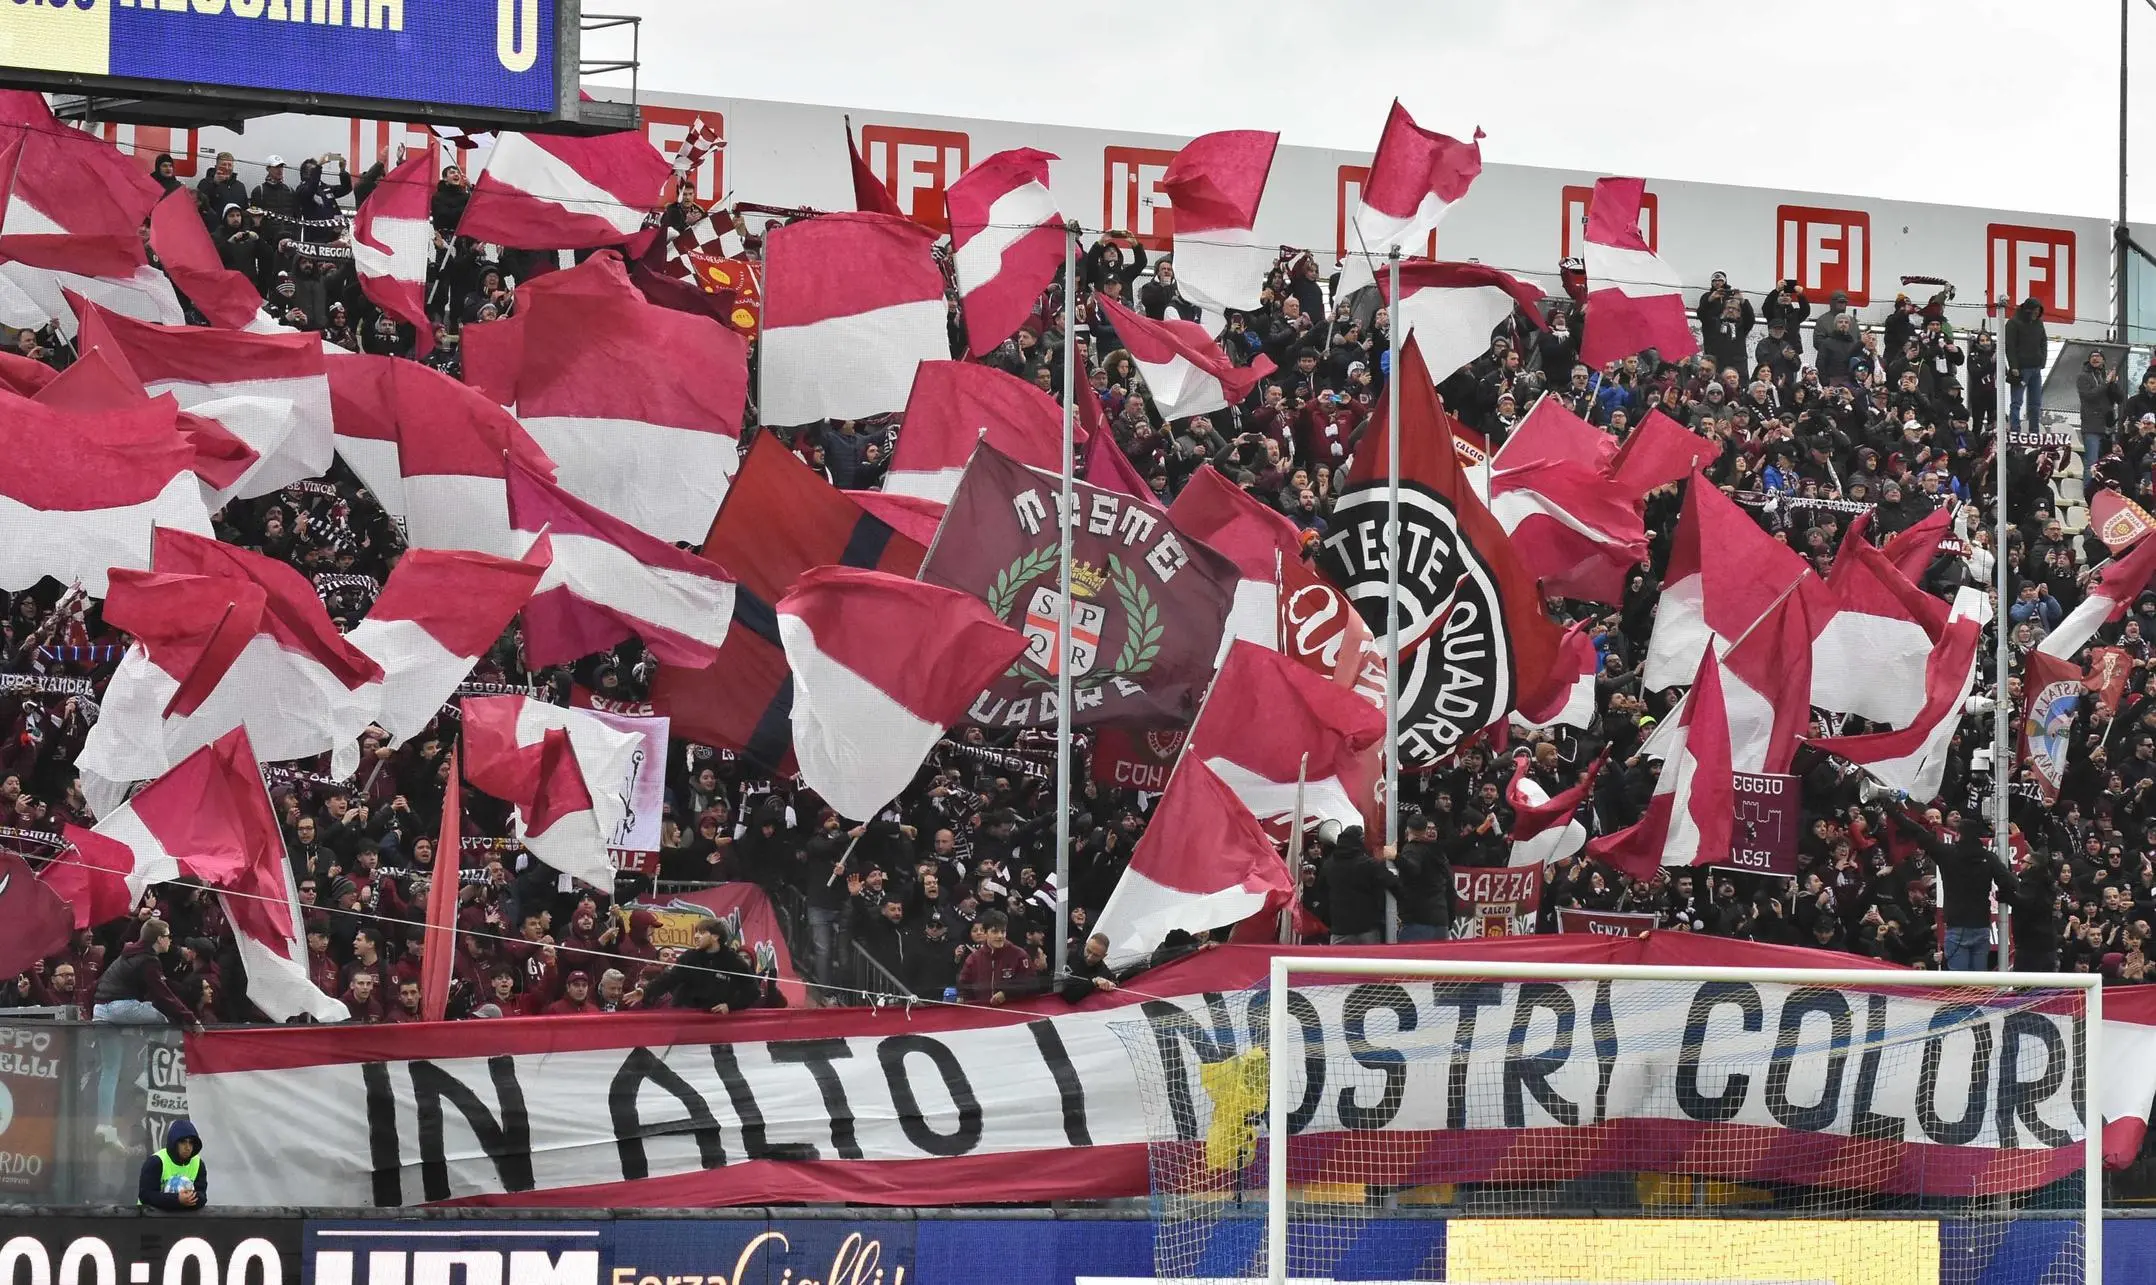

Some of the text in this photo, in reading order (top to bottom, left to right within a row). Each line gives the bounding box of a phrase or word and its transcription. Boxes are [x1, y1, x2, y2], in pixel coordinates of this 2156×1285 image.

[319, 246, 352, 258] REGGIA
[1783, 220, 1863, 292] IFI
[1993, 238, 2069, 310] IFI
[2006, 431, 2071, 445] EGGIANA
[1456, 441, 1485, 462] CALCIO
[1324, 519, 1450, 594] TESTE
[1038, 594, 1097, 627] S P
[1030, 633, 1086, 668] Q R
[456, 681, 538, 697] EGGIANA
[1398, 601, 1486, 761] QUADRE
[459, 836, 492, 850] PPO
[1733, 847, 1771, 867] LESI
[1454, 871, 1534, 902] RAZZA
[1482, 906, 1511, 915] CALCIO
[1589, 920, 1629, 937] SENZA
[363, 1055, 535, 1207] IN
[607, 1034, 984, 1180] ALTO
[1027, 1017, 1092, 1147] I
[1140, 979, 1618, 1140] NOSTRI
